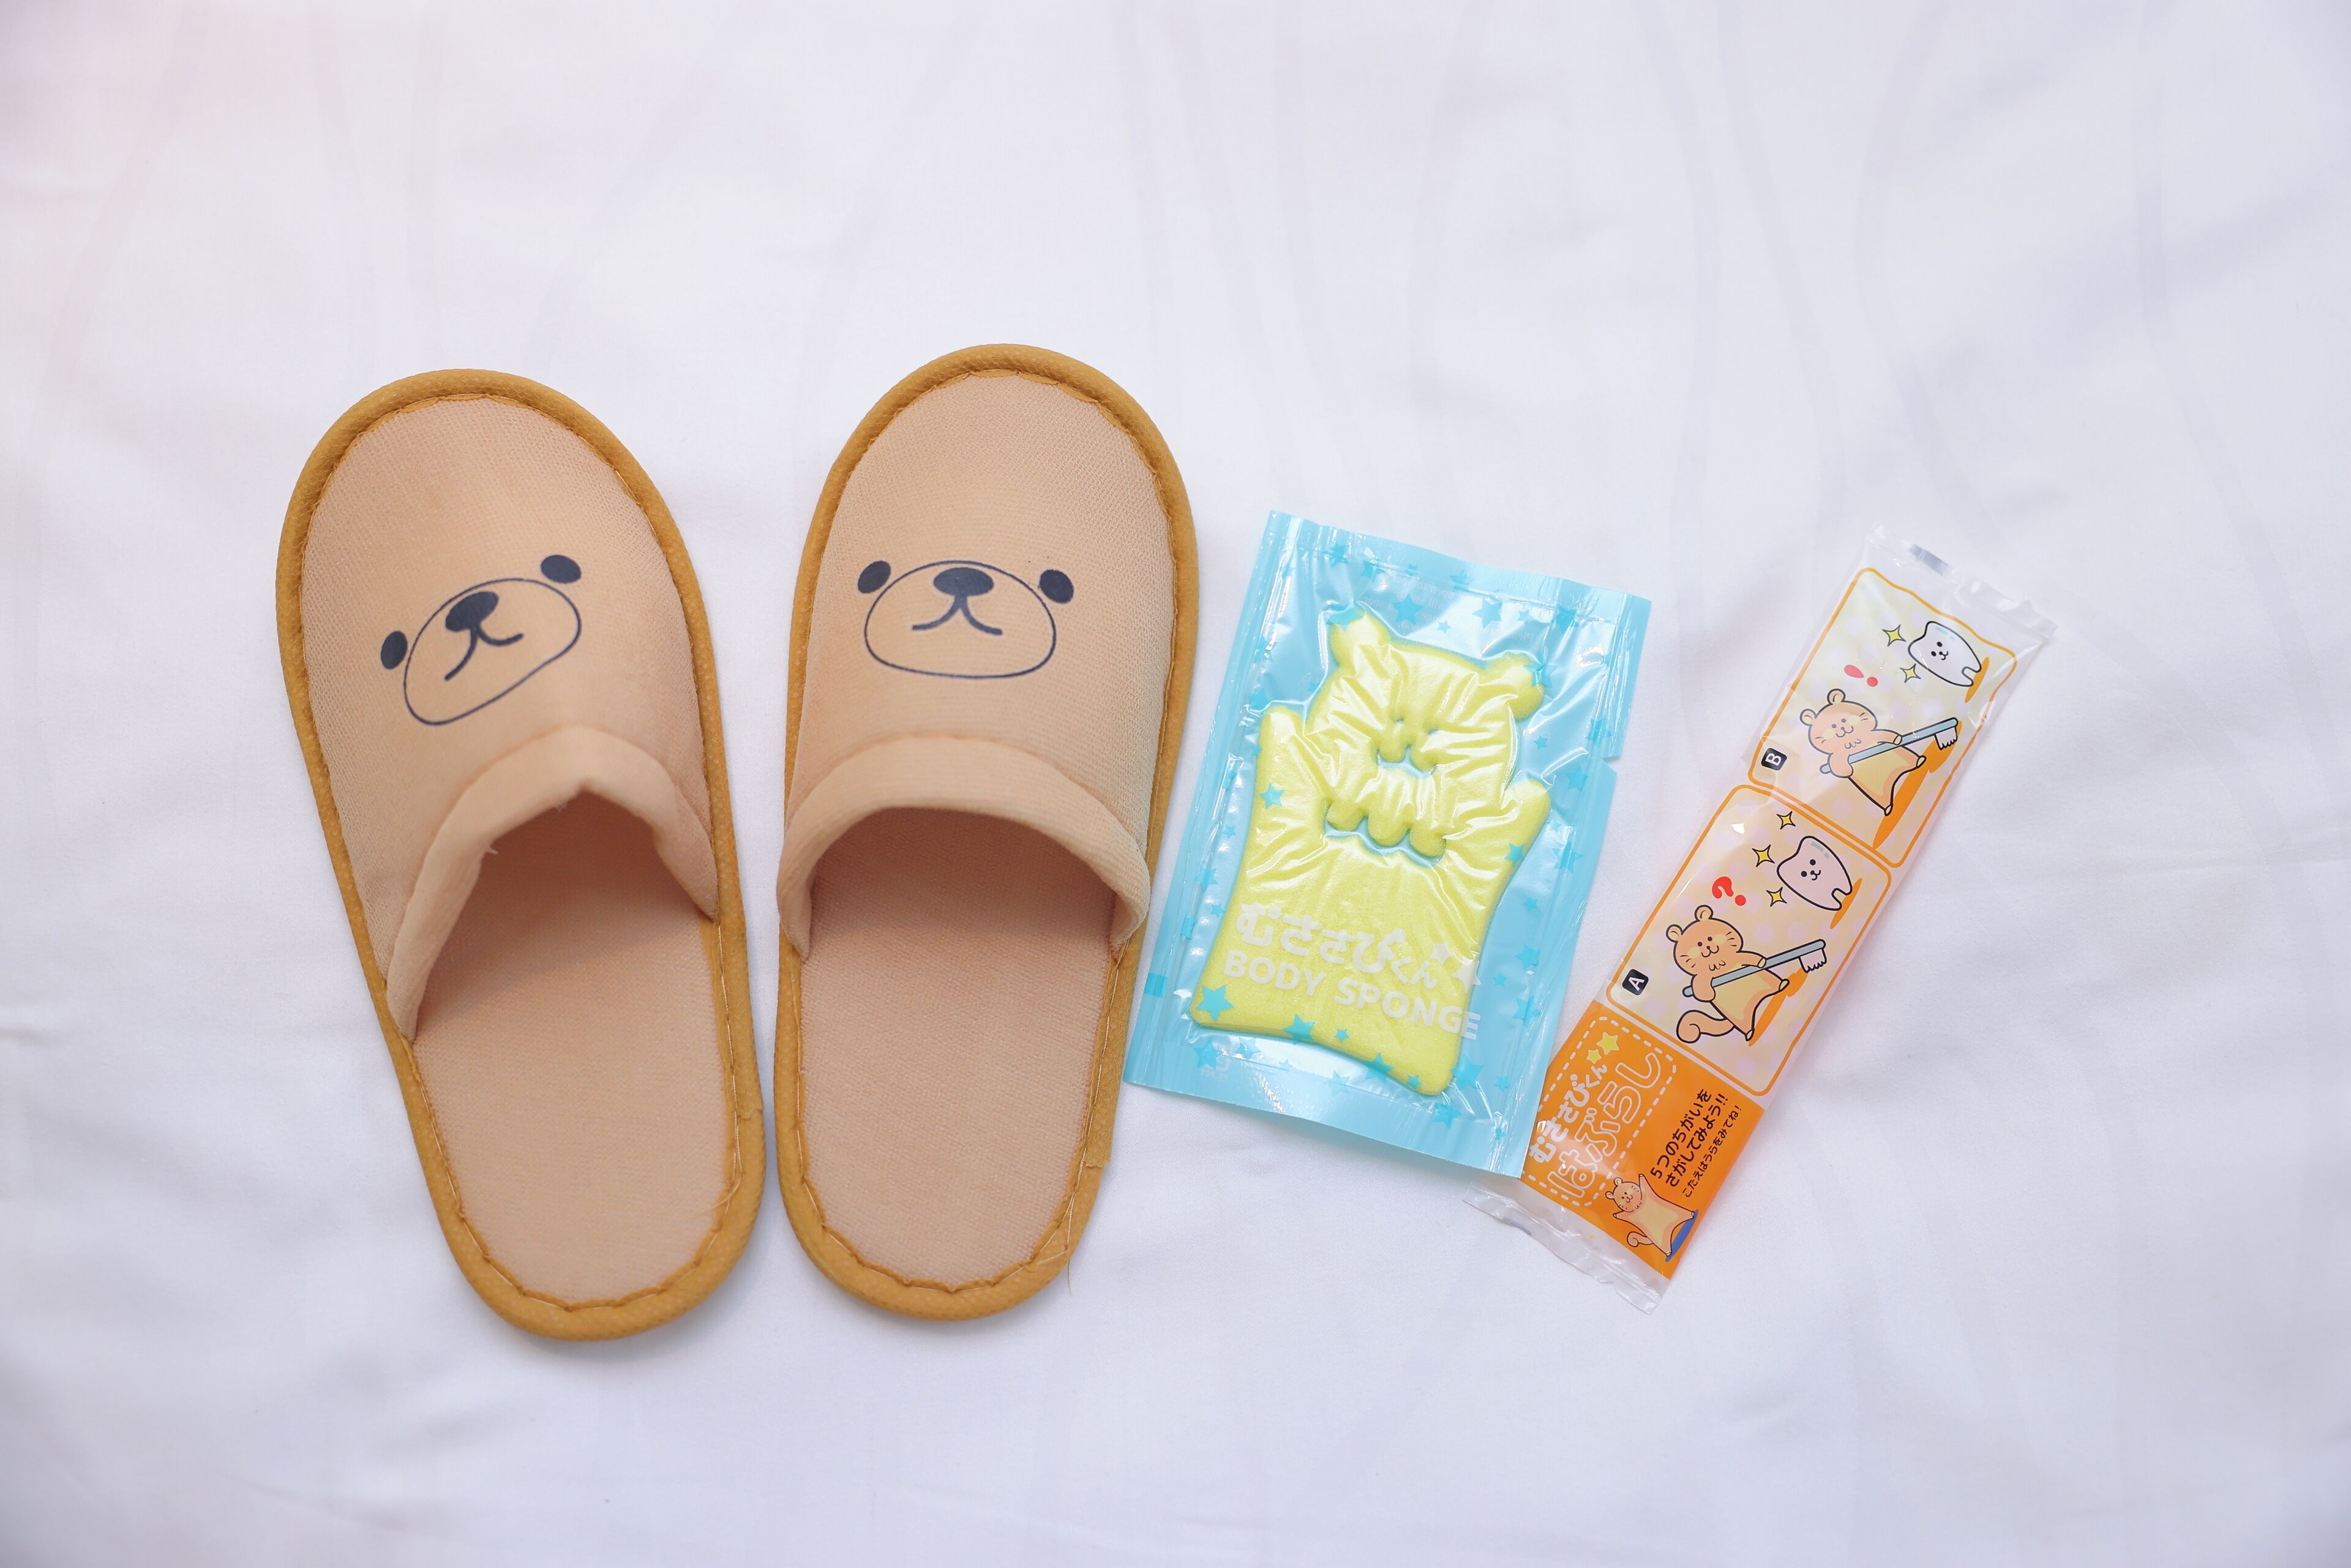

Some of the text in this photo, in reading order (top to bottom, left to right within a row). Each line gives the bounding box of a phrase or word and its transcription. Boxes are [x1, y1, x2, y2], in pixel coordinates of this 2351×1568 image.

[1765, 752, 1782, 766] B
[1235, 902, 1439, 989] むささびくん
[1628, 976, 1645, 991] A
[1224, 950, 1482, 1040] BODY SPONGE
[1547, 1052, 1661, 1198] はぶらし
[1650, 1089, 1712, 1179] 5つのちがいを
